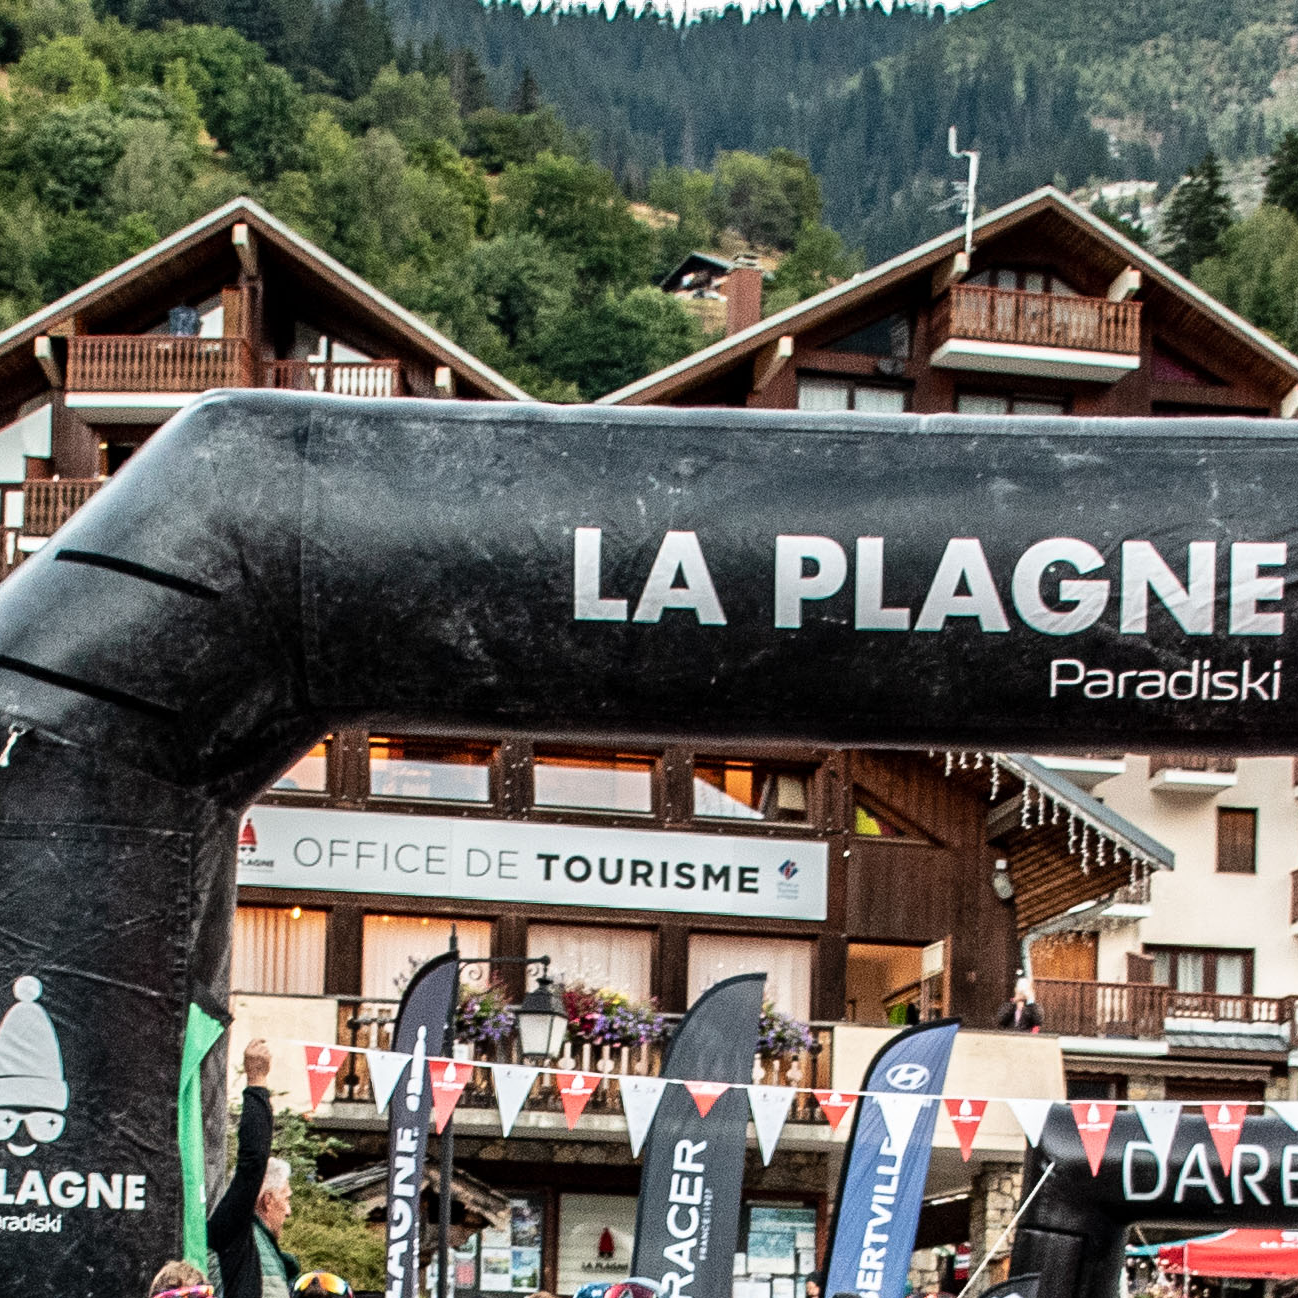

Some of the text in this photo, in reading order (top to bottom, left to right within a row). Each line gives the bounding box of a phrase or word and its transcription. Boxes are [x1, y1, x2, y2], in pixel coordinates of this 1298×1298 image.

[574, 527, 1288, 636] LA PLAGNE
[1049, 658, 1282, 701] Paradiski
[292, 837, 448, 876] OFFICE
[465, 847, 520, 881] DE
[536, 852, 761, 895] TOURISME
